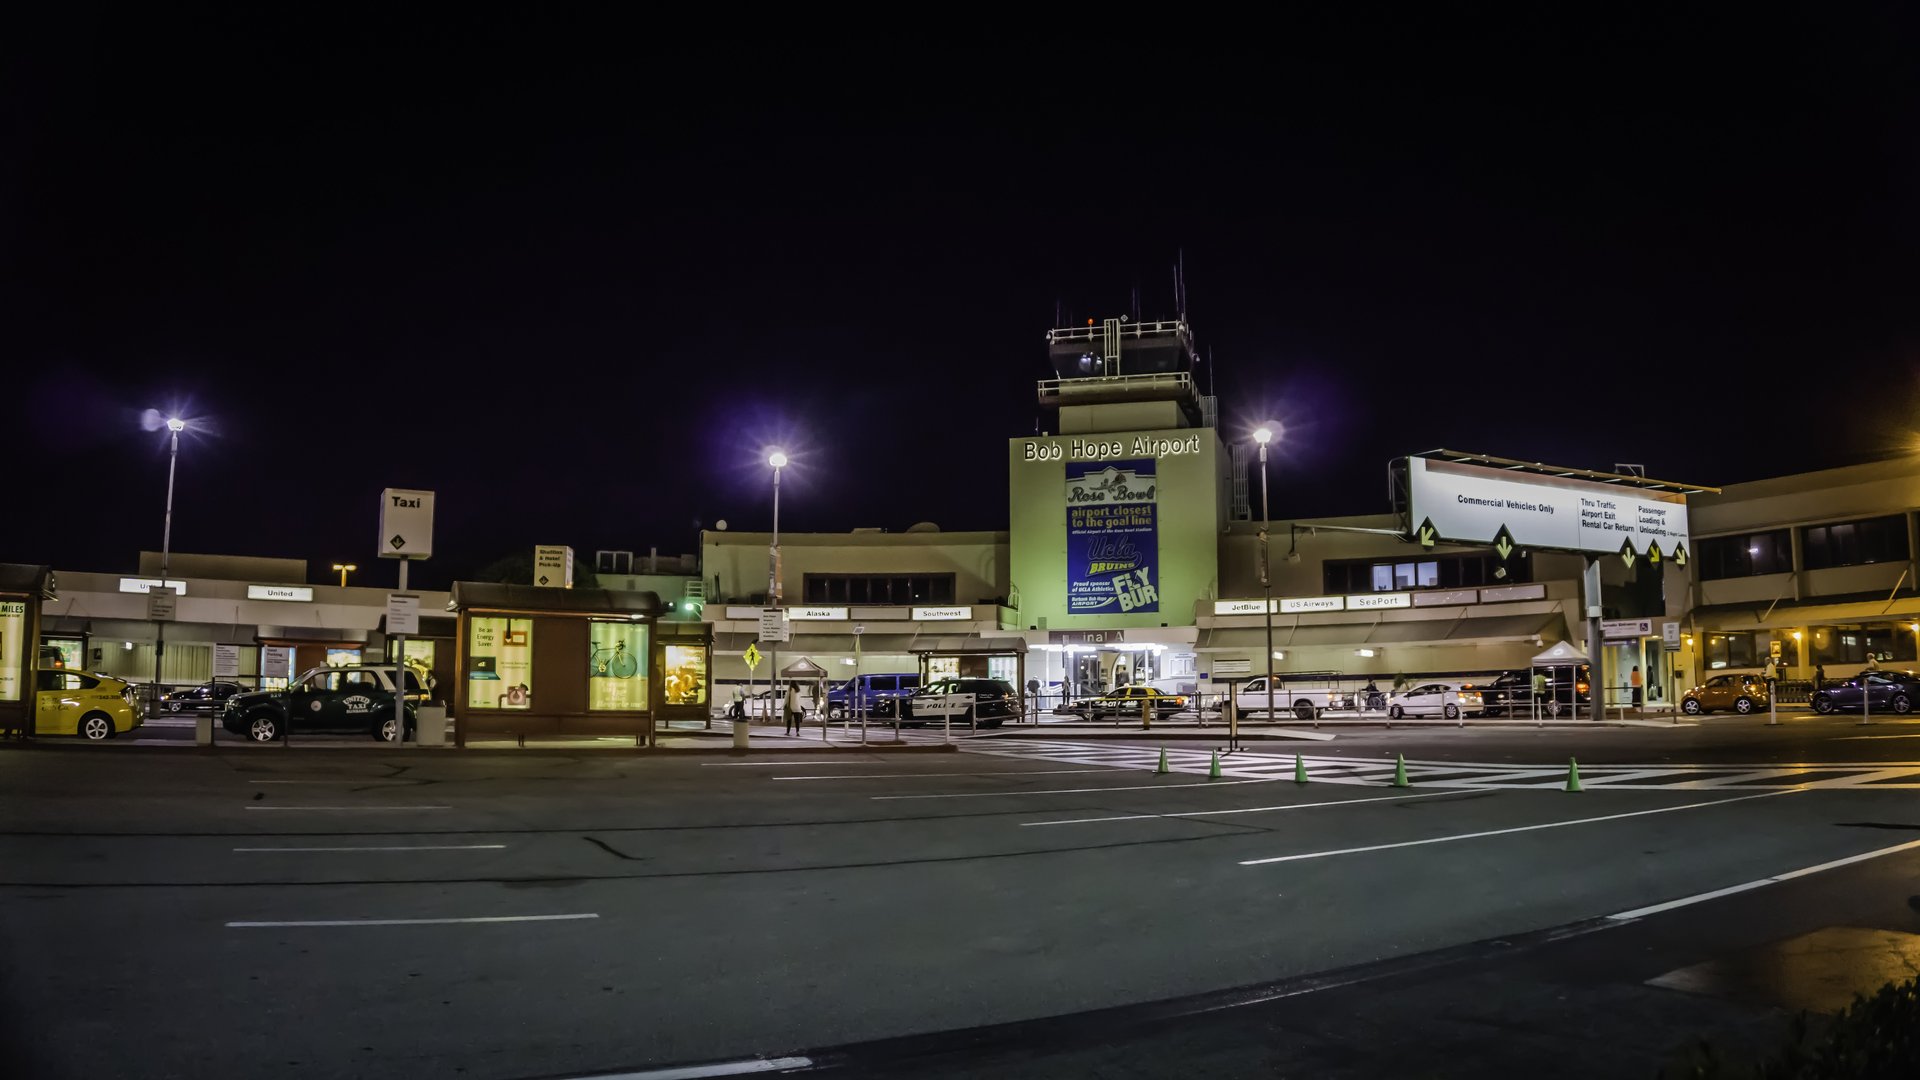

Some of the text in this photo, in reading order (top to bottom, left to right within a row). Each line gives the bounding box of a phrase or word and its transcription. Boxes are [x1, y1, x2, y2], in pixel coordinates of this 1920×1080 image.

[1024, 435, 1200, 461] Bob Hope Airport
[1068, 485, 1155, 502] Rose Bowl
[392, 496, 421, 508] Taxi
[1457, 494, 1554, 514] Commercial Vehicles Only
[1581, 498, 1616, 509] Thru Traffic
[1072, 505, 1151, 518] airport closest
[1581, 509, 1616, 520] Airport Exit
[1638, 505, 1666, 516] Passenger
[1072, 516, 1152, 528] to the goal line
[1582, 519, 1635, 532] Rental Car Return
[1639, 515, 1666, 526] Loading &
[1639, 526, 1666, 537] Unloading
[1089, 562, 1135, 574] BRUINS
[1112, 566, 1149, 595] FLY
[1118, 585, 1158, 612] BUR
[1303, 600, 1334, 608] Airways
[1360, 597, 1398, 606] SeaPort
[2, 605, 24, 613] MILES
[1115, 631, 1124, 642] A
[342, 695, 370, 705] UNITED
